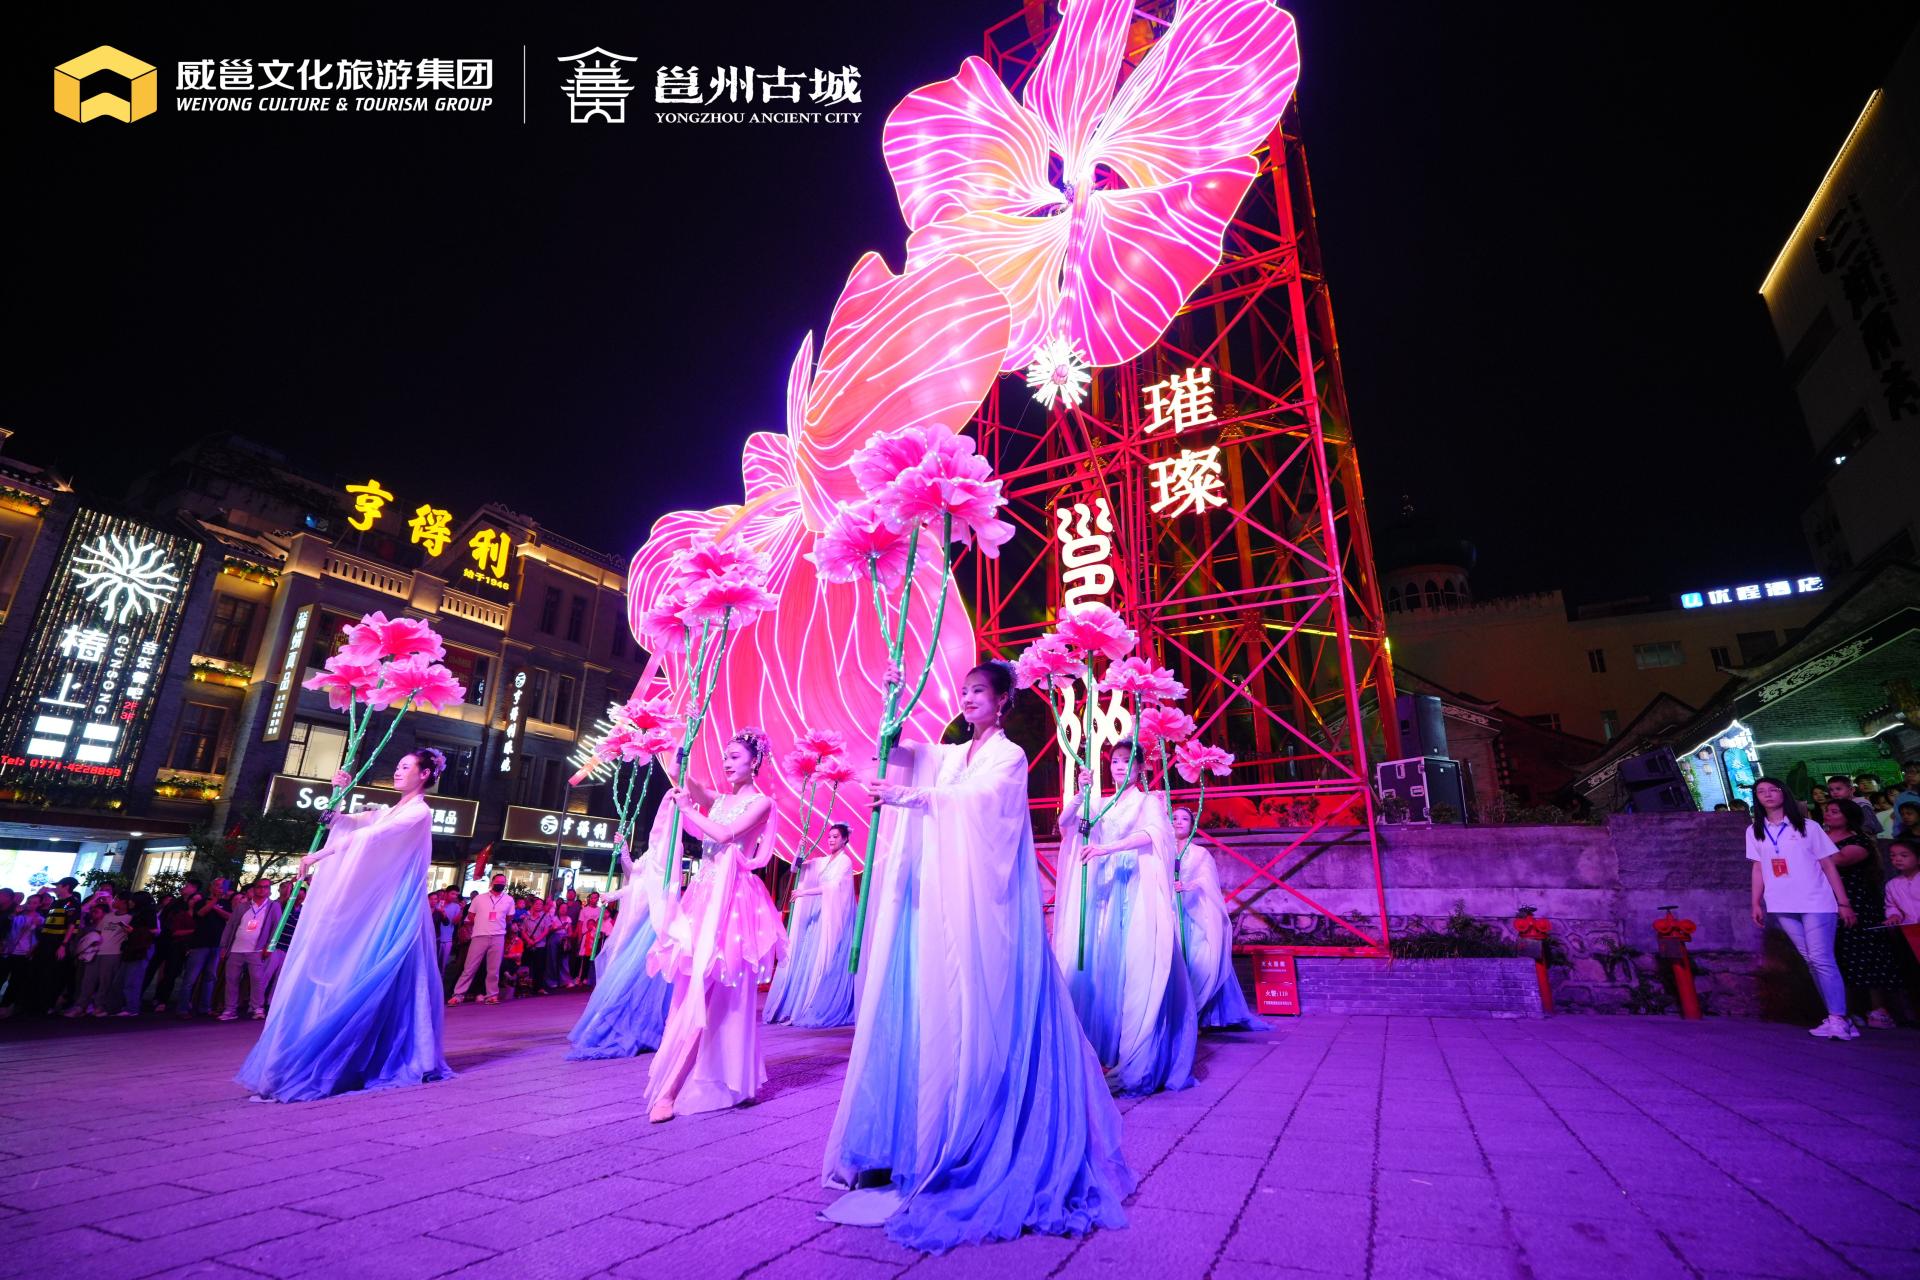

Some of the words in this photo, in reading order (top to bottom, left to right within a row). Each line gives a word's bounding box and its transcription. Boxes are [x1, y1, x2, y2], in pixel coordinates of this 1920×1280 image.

[1141, 367, 1227, 519] 璀璨
[345, 479, 511, 579] 亨得利
[463, 567, 510, 591] 始于1946
